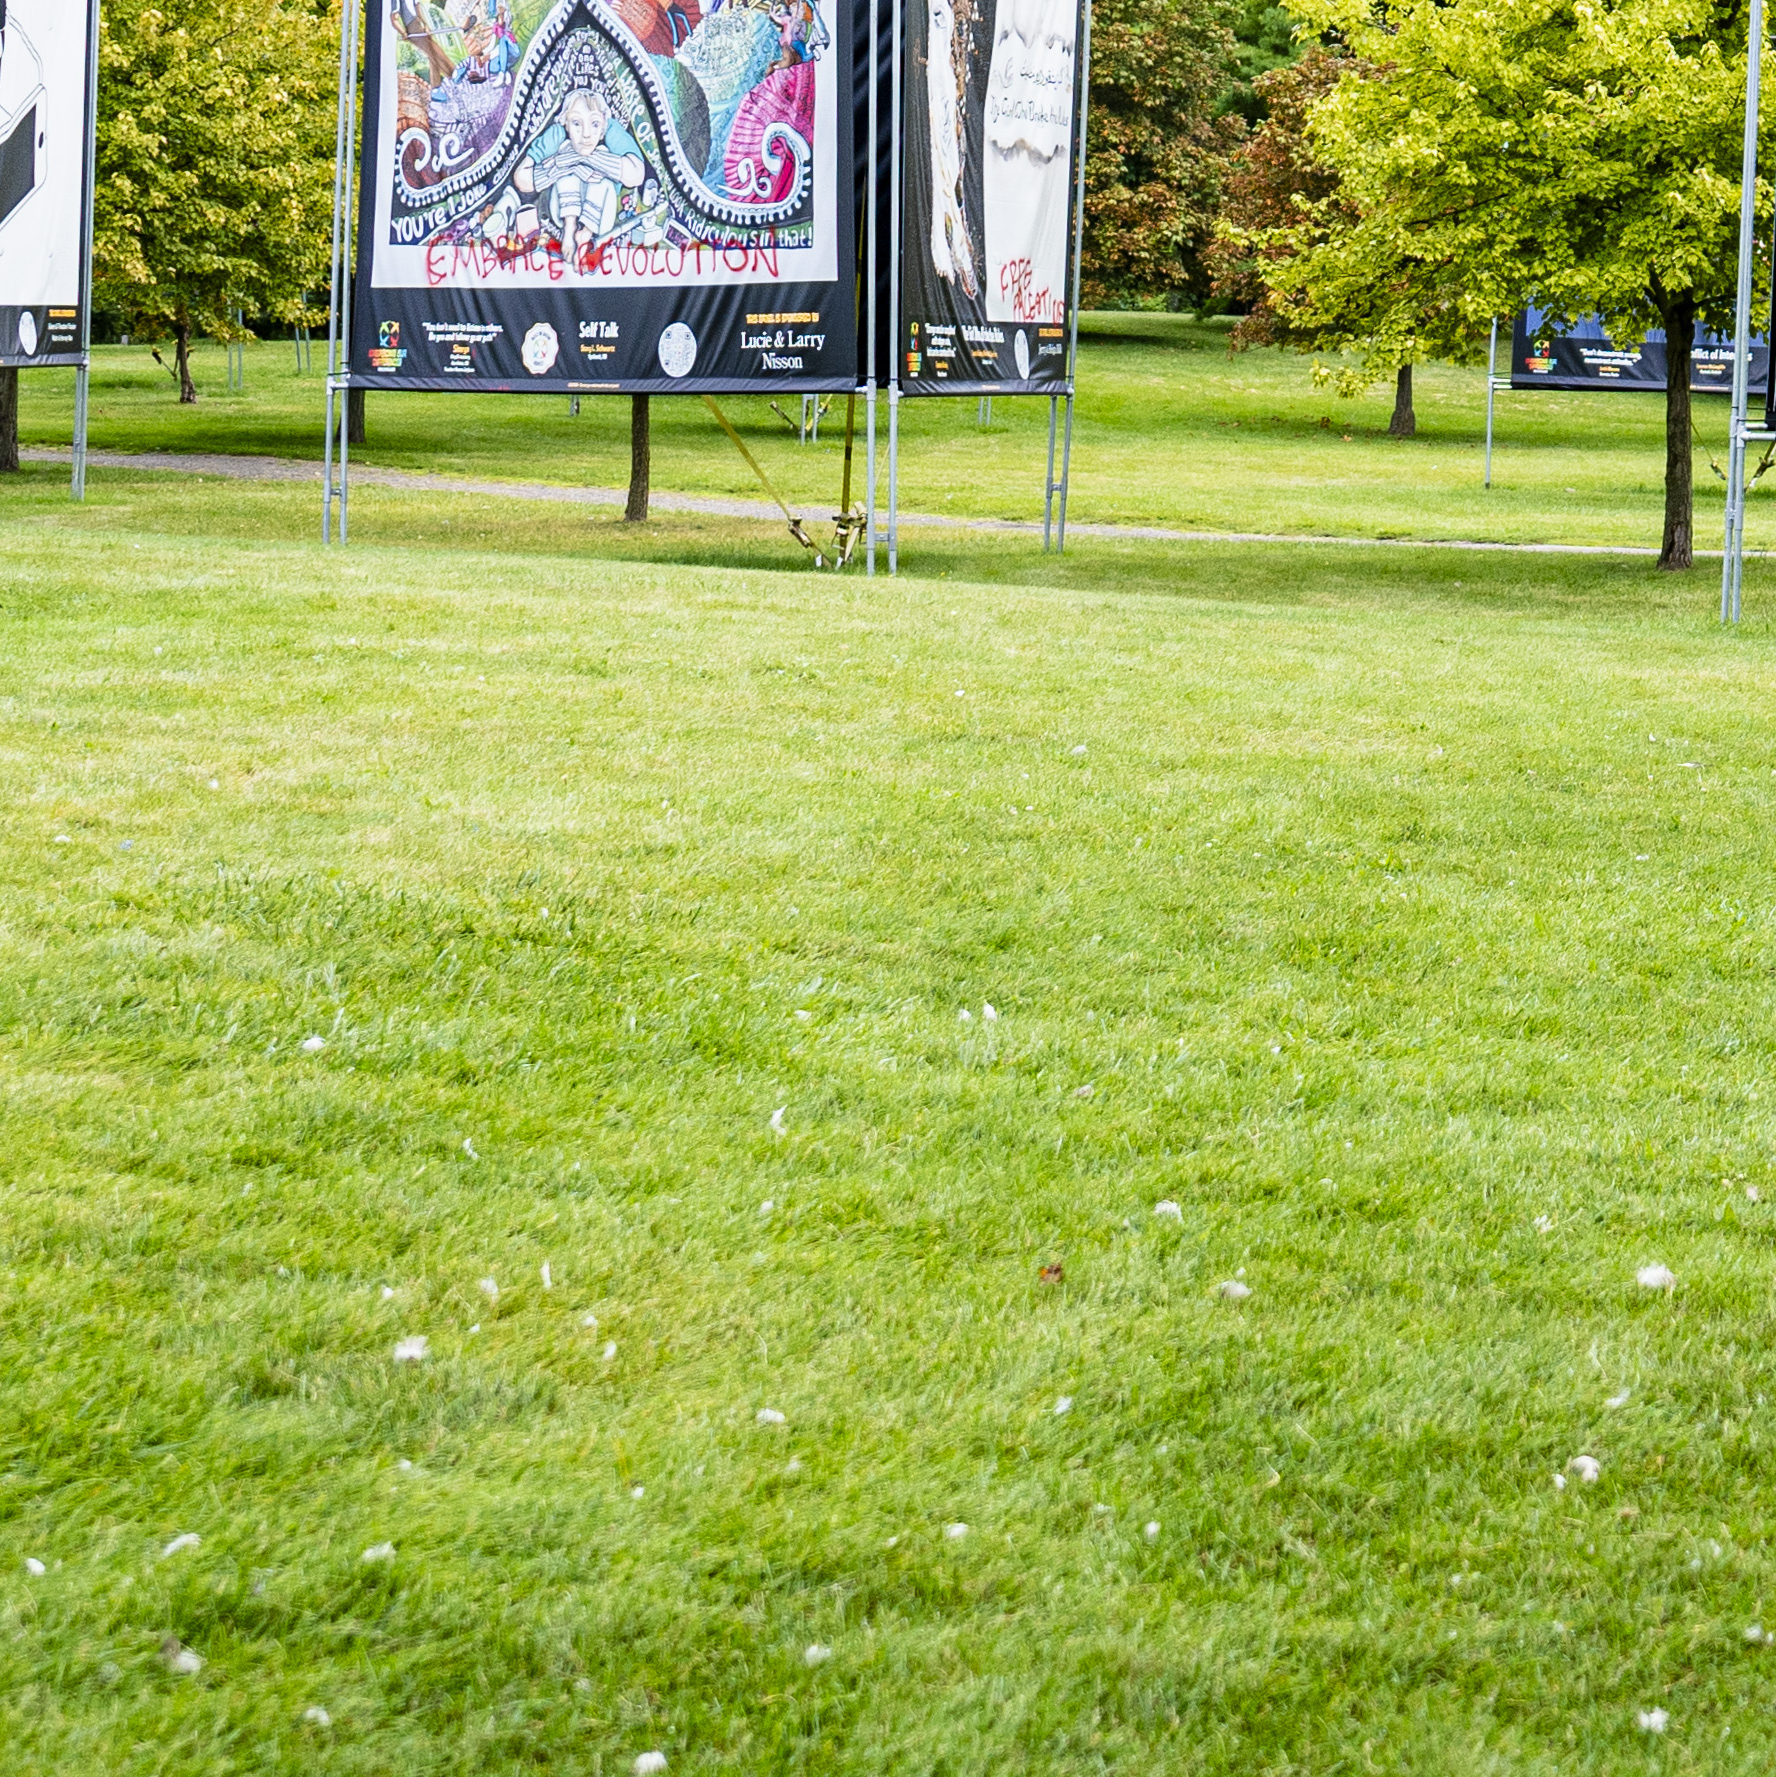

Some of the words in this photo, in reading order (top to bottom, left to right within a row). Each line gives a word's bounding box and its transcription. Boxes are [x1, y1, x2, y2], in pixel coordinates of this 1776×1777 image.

[426, 233, 565, 285] EMBRACE
[577, 224, 779, 277] REVOLUTION
[579, 321, 598, 338] Self
[599, 321, 619, 338] Talk
[741, 331, 772, 349] Lucie
[774, 330, 784, 347] &
[788, 330, 825, 350] Larry
[762, 352, 803, 369] Nisson
[1710, 349, 1718, 359] of
